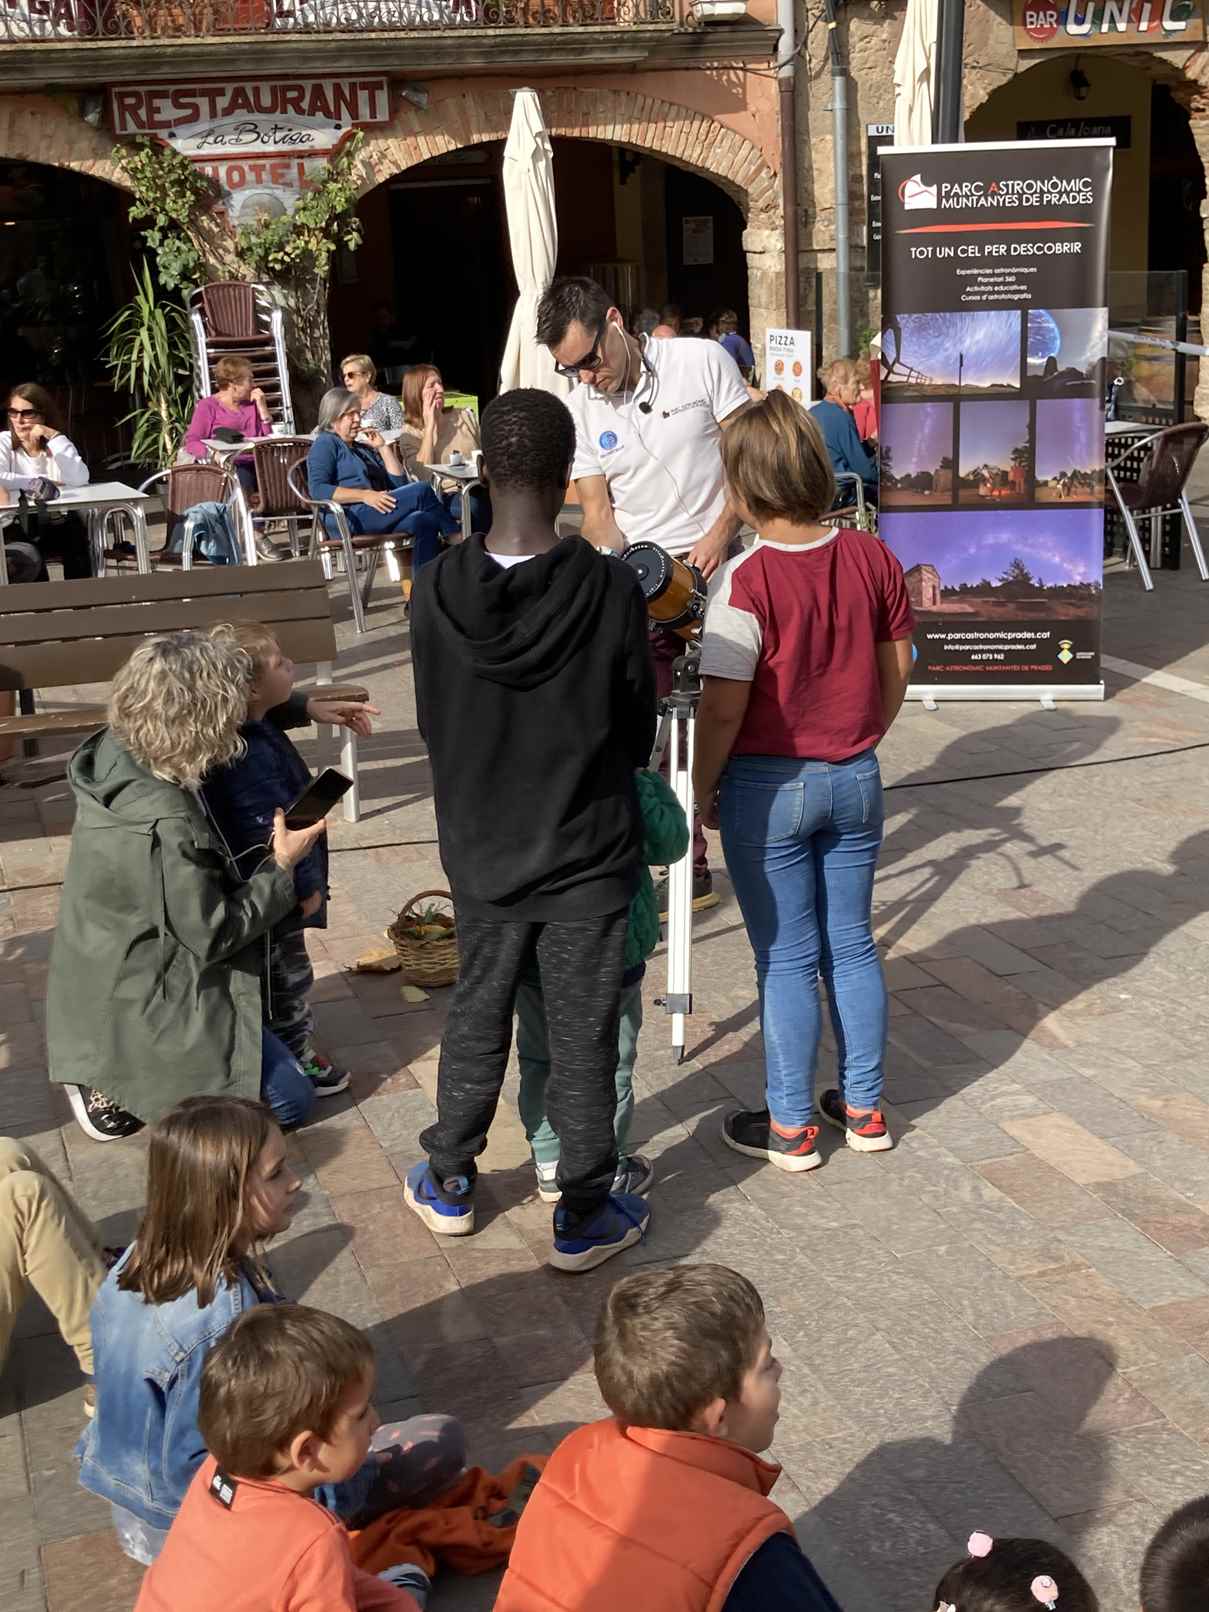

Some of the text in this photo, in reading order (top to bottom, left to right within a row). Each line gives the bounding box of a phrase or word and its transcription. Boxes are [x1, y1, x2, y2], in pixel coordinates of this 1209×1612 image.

[1026, 11, 1057, 29] BAR
[117, 81, 384, 131] RESTAURANT
[197, 122, 315, 149] La Botiga
[941, 176, 1092, 196] PARC ASTRONÒMIC
[941, 191, 1093, 209] MUNTANYES DE PRADES
[911, 242, 1082, 259] TOT UN CEL PER DESCOBRIR
[769, 335, 796, 346] PIZZA
[926, 631, 1051, 640] www.parcastronomicprades.cat
